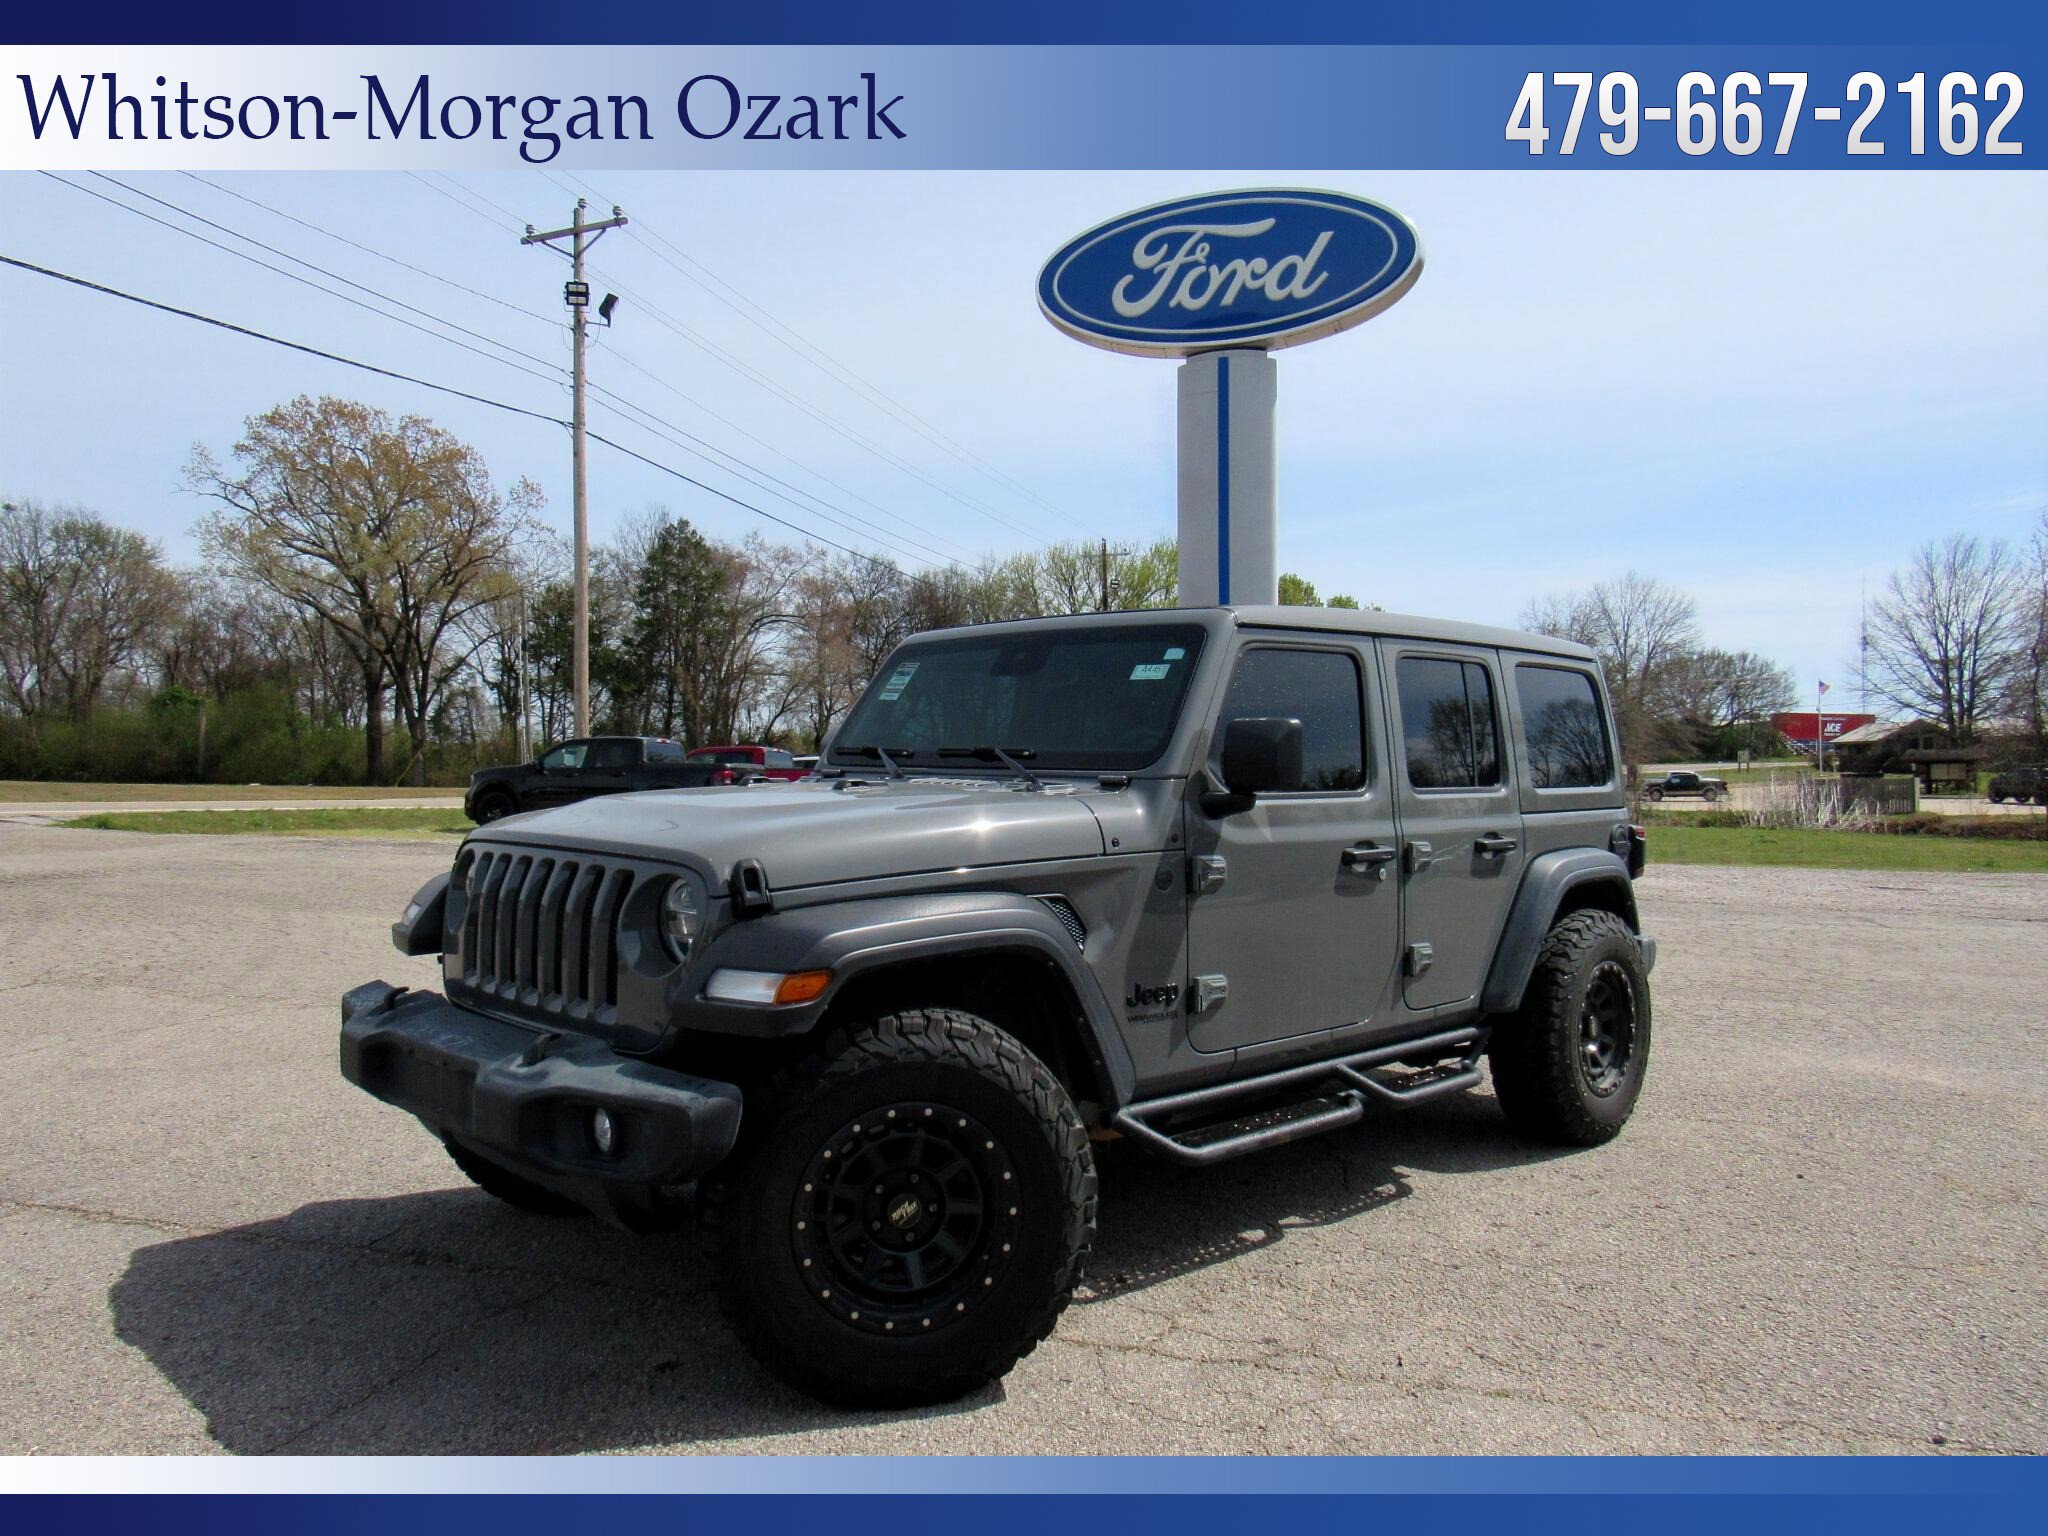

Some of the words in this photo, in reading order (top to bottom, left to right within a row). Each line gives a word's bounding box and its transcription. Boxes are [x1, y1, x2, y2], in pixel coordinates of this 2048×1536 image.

[1112, 217, 1335, 318] Ford
[1824, 722, 1841, 733] ACE
[1126, 983, 1179, 1008] Jeep
